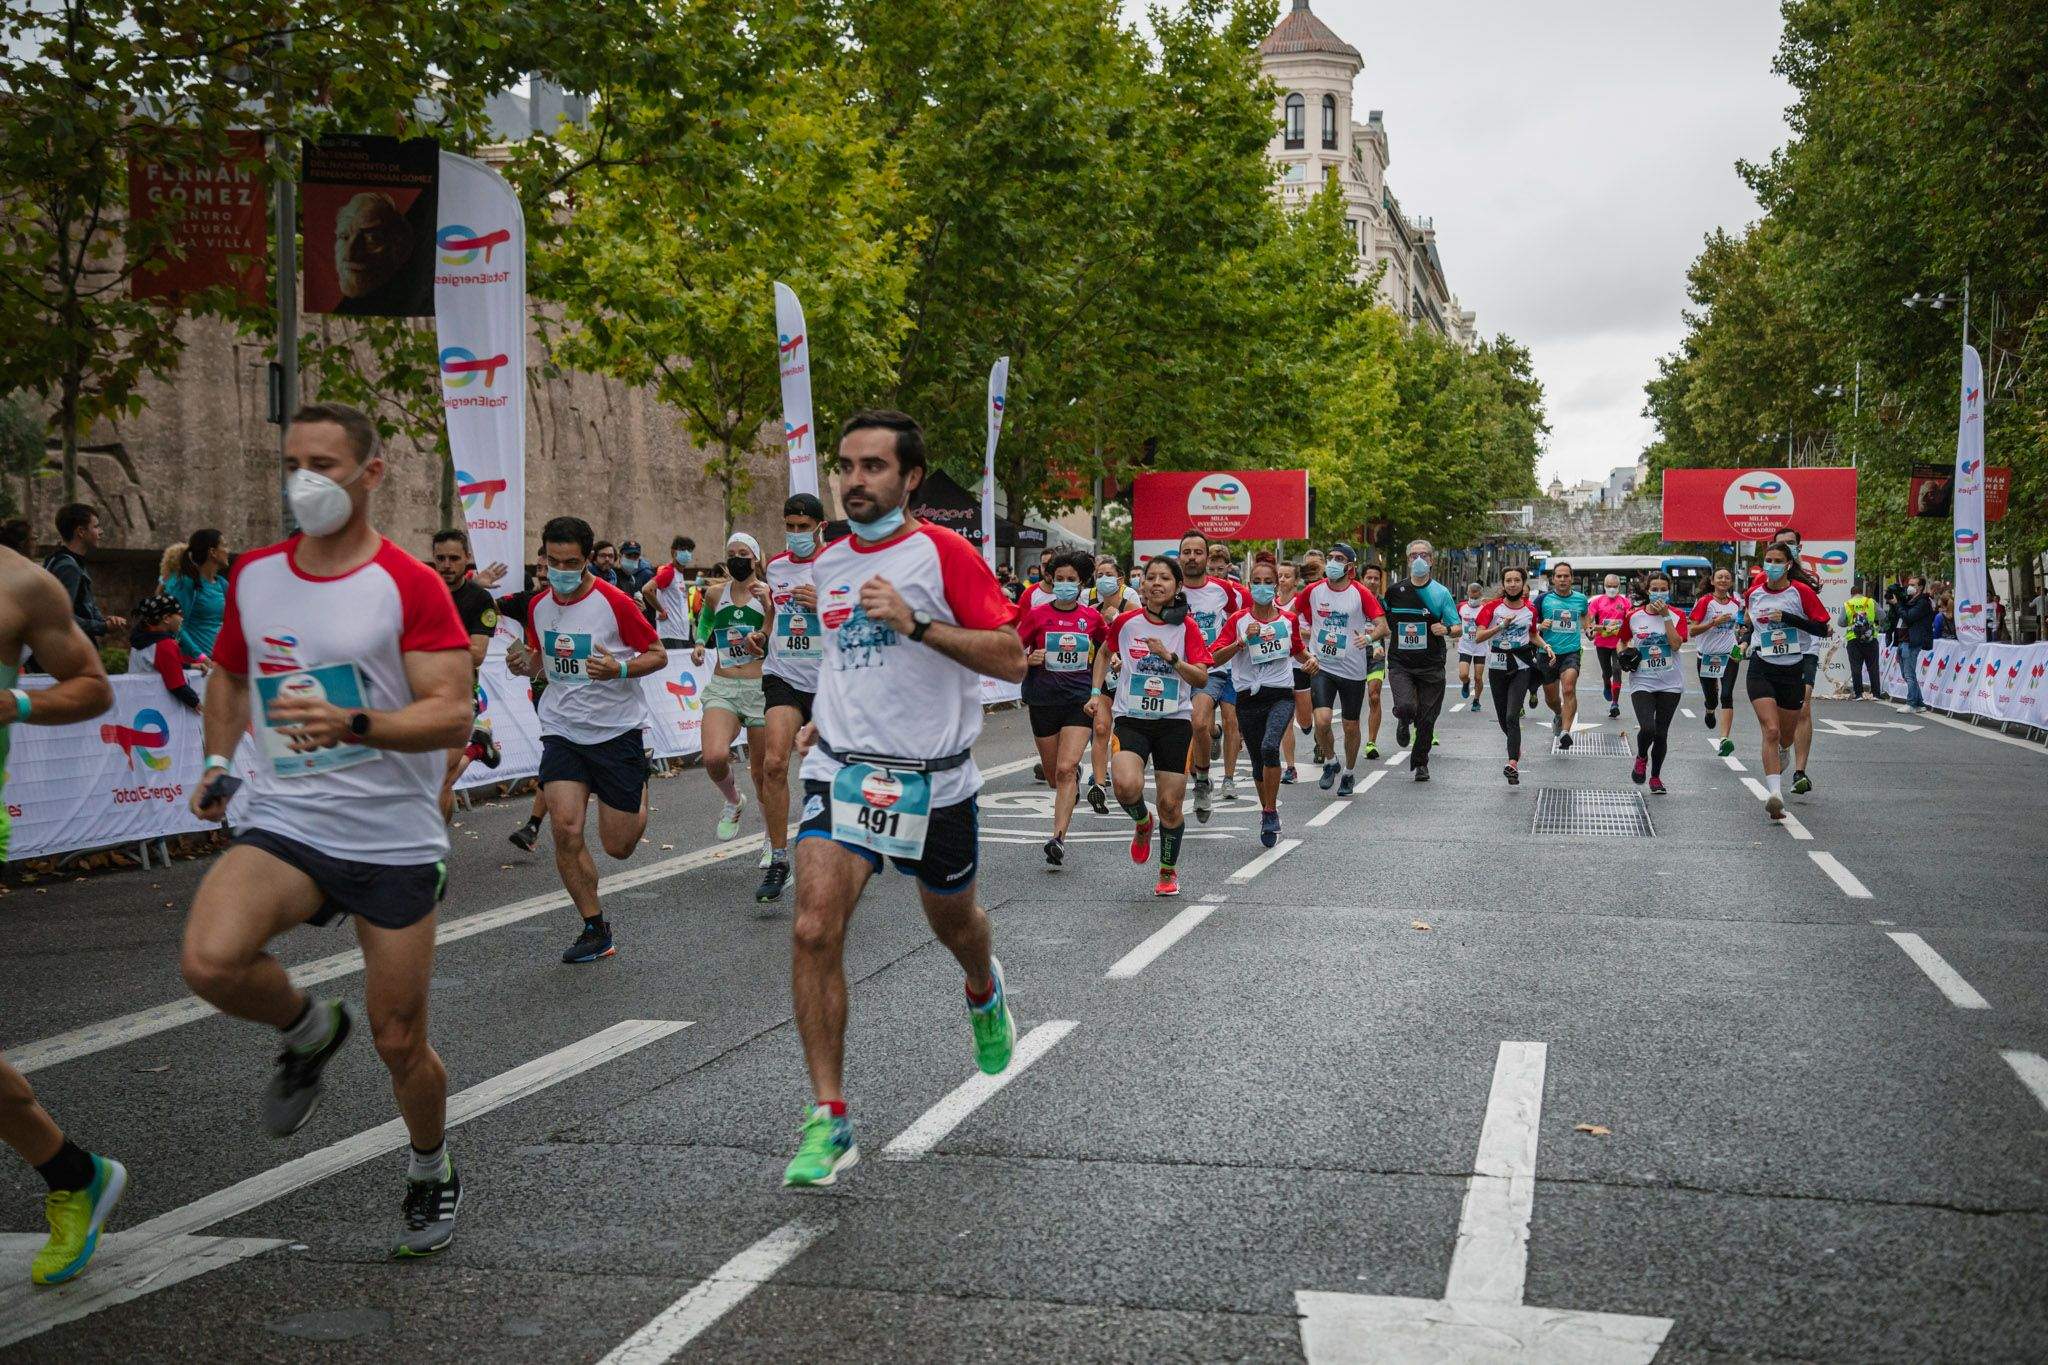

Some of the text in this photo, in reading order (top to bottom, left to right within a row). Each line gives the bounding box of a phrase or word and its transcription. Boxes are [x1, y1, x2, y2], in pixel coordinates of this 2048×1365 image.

[147, 182, 251, 206] GÓMEZ
[1739, 503, 1782, 511] TotalEnergies
[786, 636, 810, 650] 489
[1404, 635, 1419, 645] 490
[1260, 640, 1282, 655] 526
[1321, 644, 1338, 656] 468
[1772, 643, 1789, 655] 467
[1056, 651, 1079, 664] 493
[1647, 658, 1667, 668] 1028
[554, 656, 580, 674] 506
[1141, 696, 1165, 711] 501
[857, 805, 901, 837] 491
